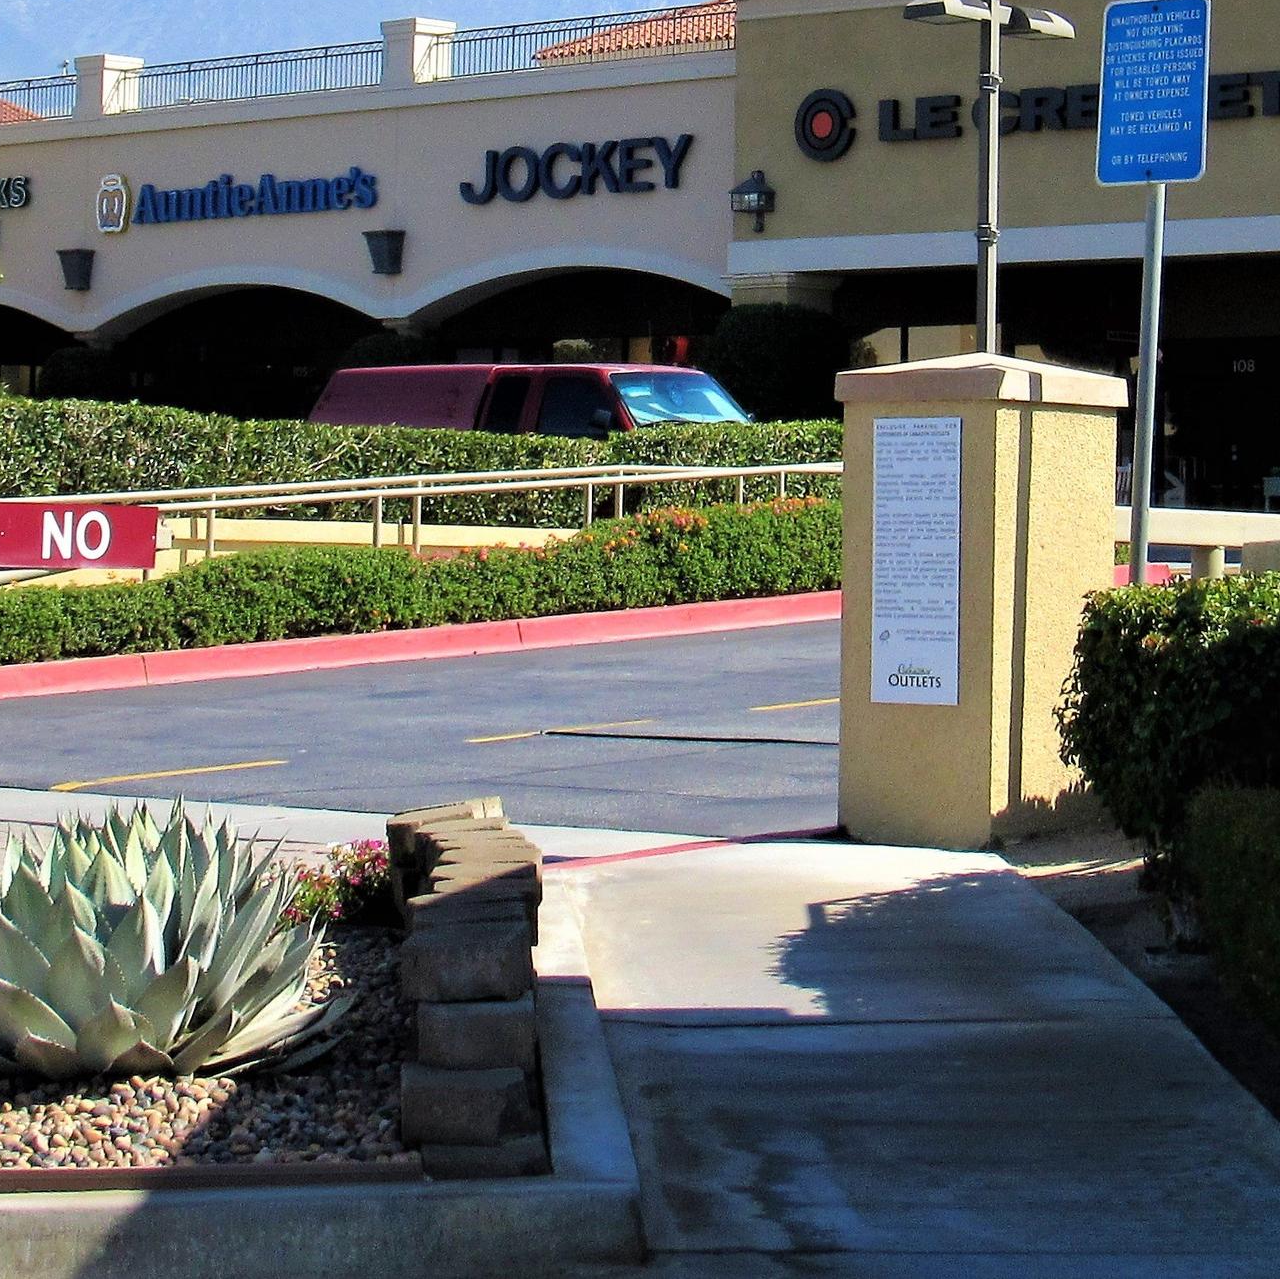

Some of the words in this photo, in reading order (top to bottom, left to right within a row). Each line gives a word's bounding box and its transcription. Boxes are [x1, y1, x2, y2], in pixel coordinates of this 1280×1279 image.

[1111, 13, 1163, 27] UNAUTHORIZED
[1166, 10, 1200, 20] VEHICLES
[1126, 28, 1139, 38] NOT
[1142, 24, 1184, 37] DISPLAYING
[1107, 39, 1162, 52] DISTINGUISHING
[1164, 35, 1203, 47] PLACARDS
[1117, 53, 1146, 64] LICENSE
[1148, 50, 1175, 62] PLATES
[1177, 48, 1204, 59] ISSUED
[1110, 67, 1124, 76] FOR
[1126, 64, 1160, 76] DISABLED
[1163, 61, 1197, 72] PERSONS
[1115, 79, 1129, 89] WILL
[1133, 78, 1142, 87] BE
[1146, 76, 1169, 87] TOWED
[1172, 74, 1191, 84] AWAY
[1114, 92, 1122, 101] AT
[1124, 89, 1154, 101] OWNER'S
[879, 95, 963, 142] LE
[1121, 111, 1145, 122] TOWED
[1148, 109, 1182, 120] VEHICLES
[1110, 126, 1124, 135] MAY
[1127, 124, 1137, 134] BE
[1140, 122, 1180, 134] RECLAIMED
[1183, 121, 1192, 130] AT
[1112, 156, 1123, 165] OR
[1124, 154, 1133, 164] BY
[1138, 152, 1188, 164] TELEPHONING
[460, 134, 694, 205] JOCKEY
[1232, 359, 1255, 373] 108
[41, 510, 111, 560] NO
[888, 673, 942, 689] OUTLETS
